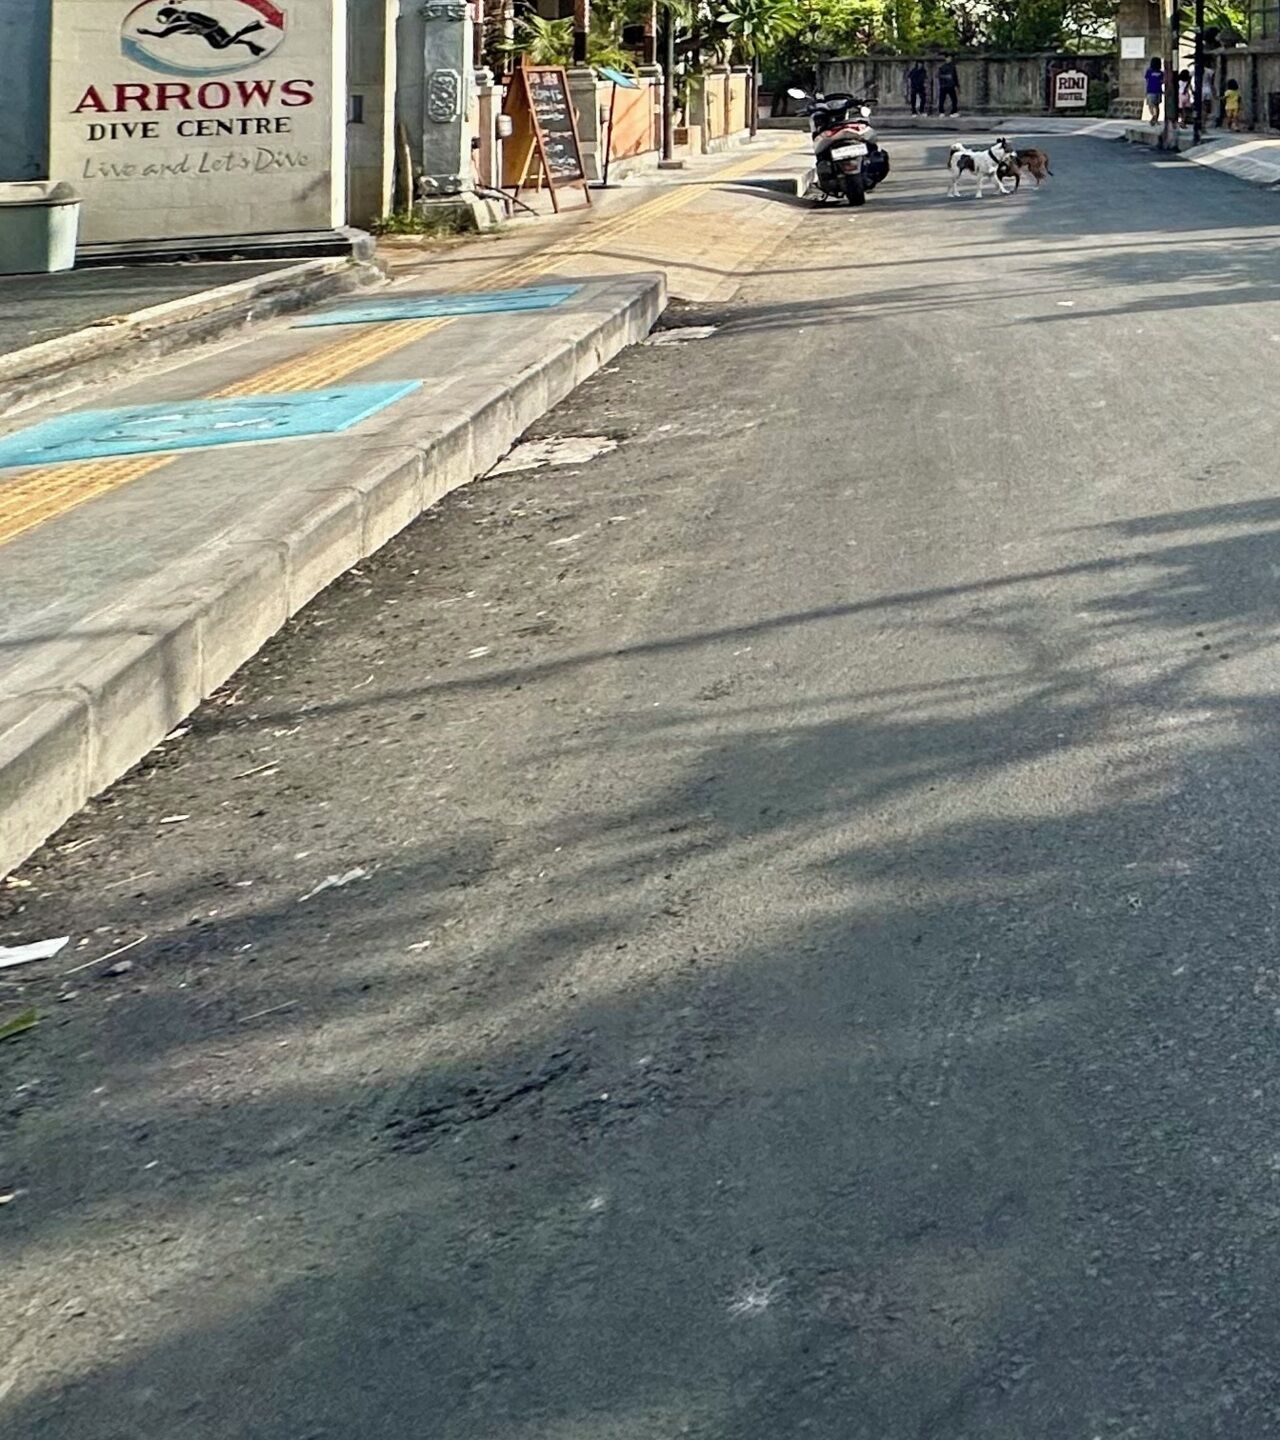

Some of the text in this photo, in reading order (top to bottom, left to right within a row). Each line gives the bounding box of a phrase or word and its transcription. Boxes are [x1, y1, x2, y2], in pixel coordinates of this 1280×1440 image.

[70, 79, 315, 114] ARROWS
[1057, 92, 1085, 101] HOTEL
[1058, 77, 1085, 90] RINI
[87, 116, 293, 142] DIVE CENTRE
[82, 157, 137, 180] Live
[141, 154, 190, 177] and
[254, 147, 309, 174] Dive
